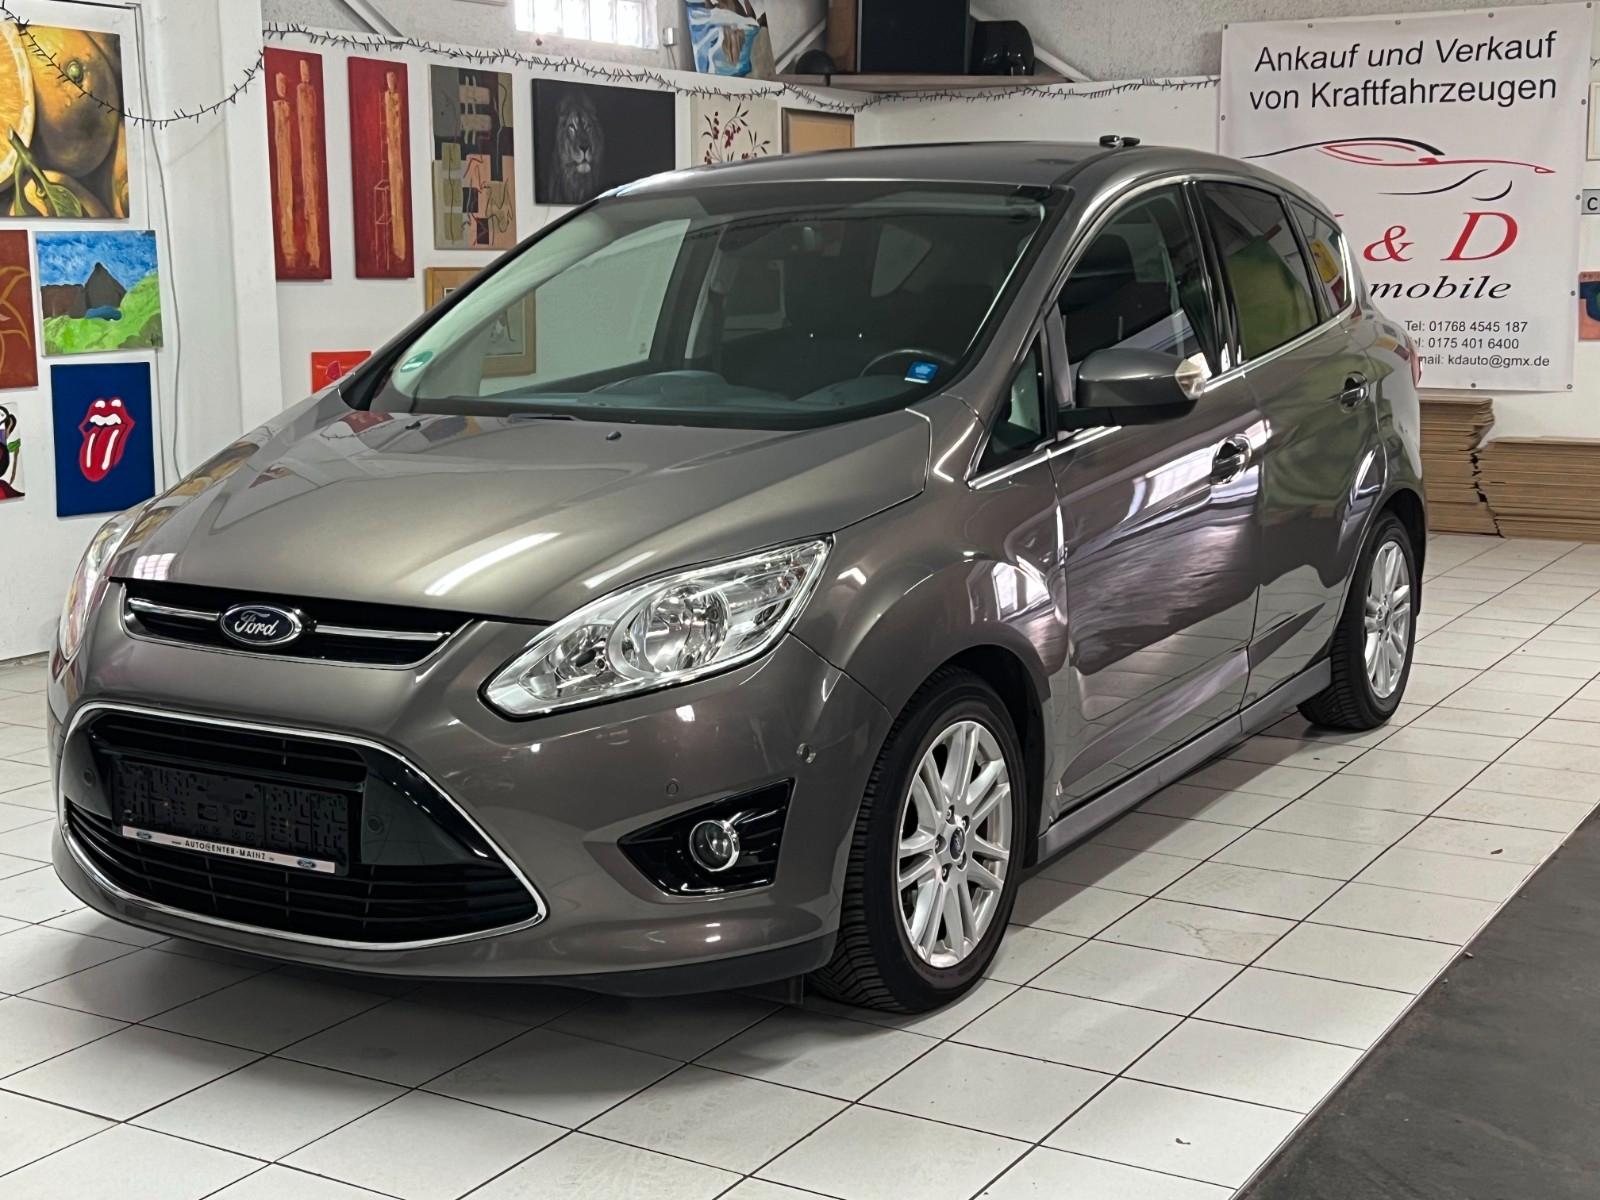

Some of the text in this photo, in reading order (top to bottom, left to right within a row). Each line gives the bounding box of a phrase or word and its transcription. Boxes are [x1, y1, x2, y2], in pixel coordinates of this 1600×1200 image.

[1254, 30, 1558, 72] Ankauf und Verkauf
[1250, 77, 1556, 110] von Kraftfahrzeugen
[1363, 212, 1518, 262] & D
[1370, 275, 1511, 299] mobile
[1404, 320, 1528, 333] Tel: 01768 4545 187
[1428, 337, 1458, 348] 0175
[1461, 337, 1483, 349] 401
[1488, 338, 1519, 349] 6400
[1448, 354, 1550, 369] kdauto@gmx.de
[234, 610, 279, 636] Ford
